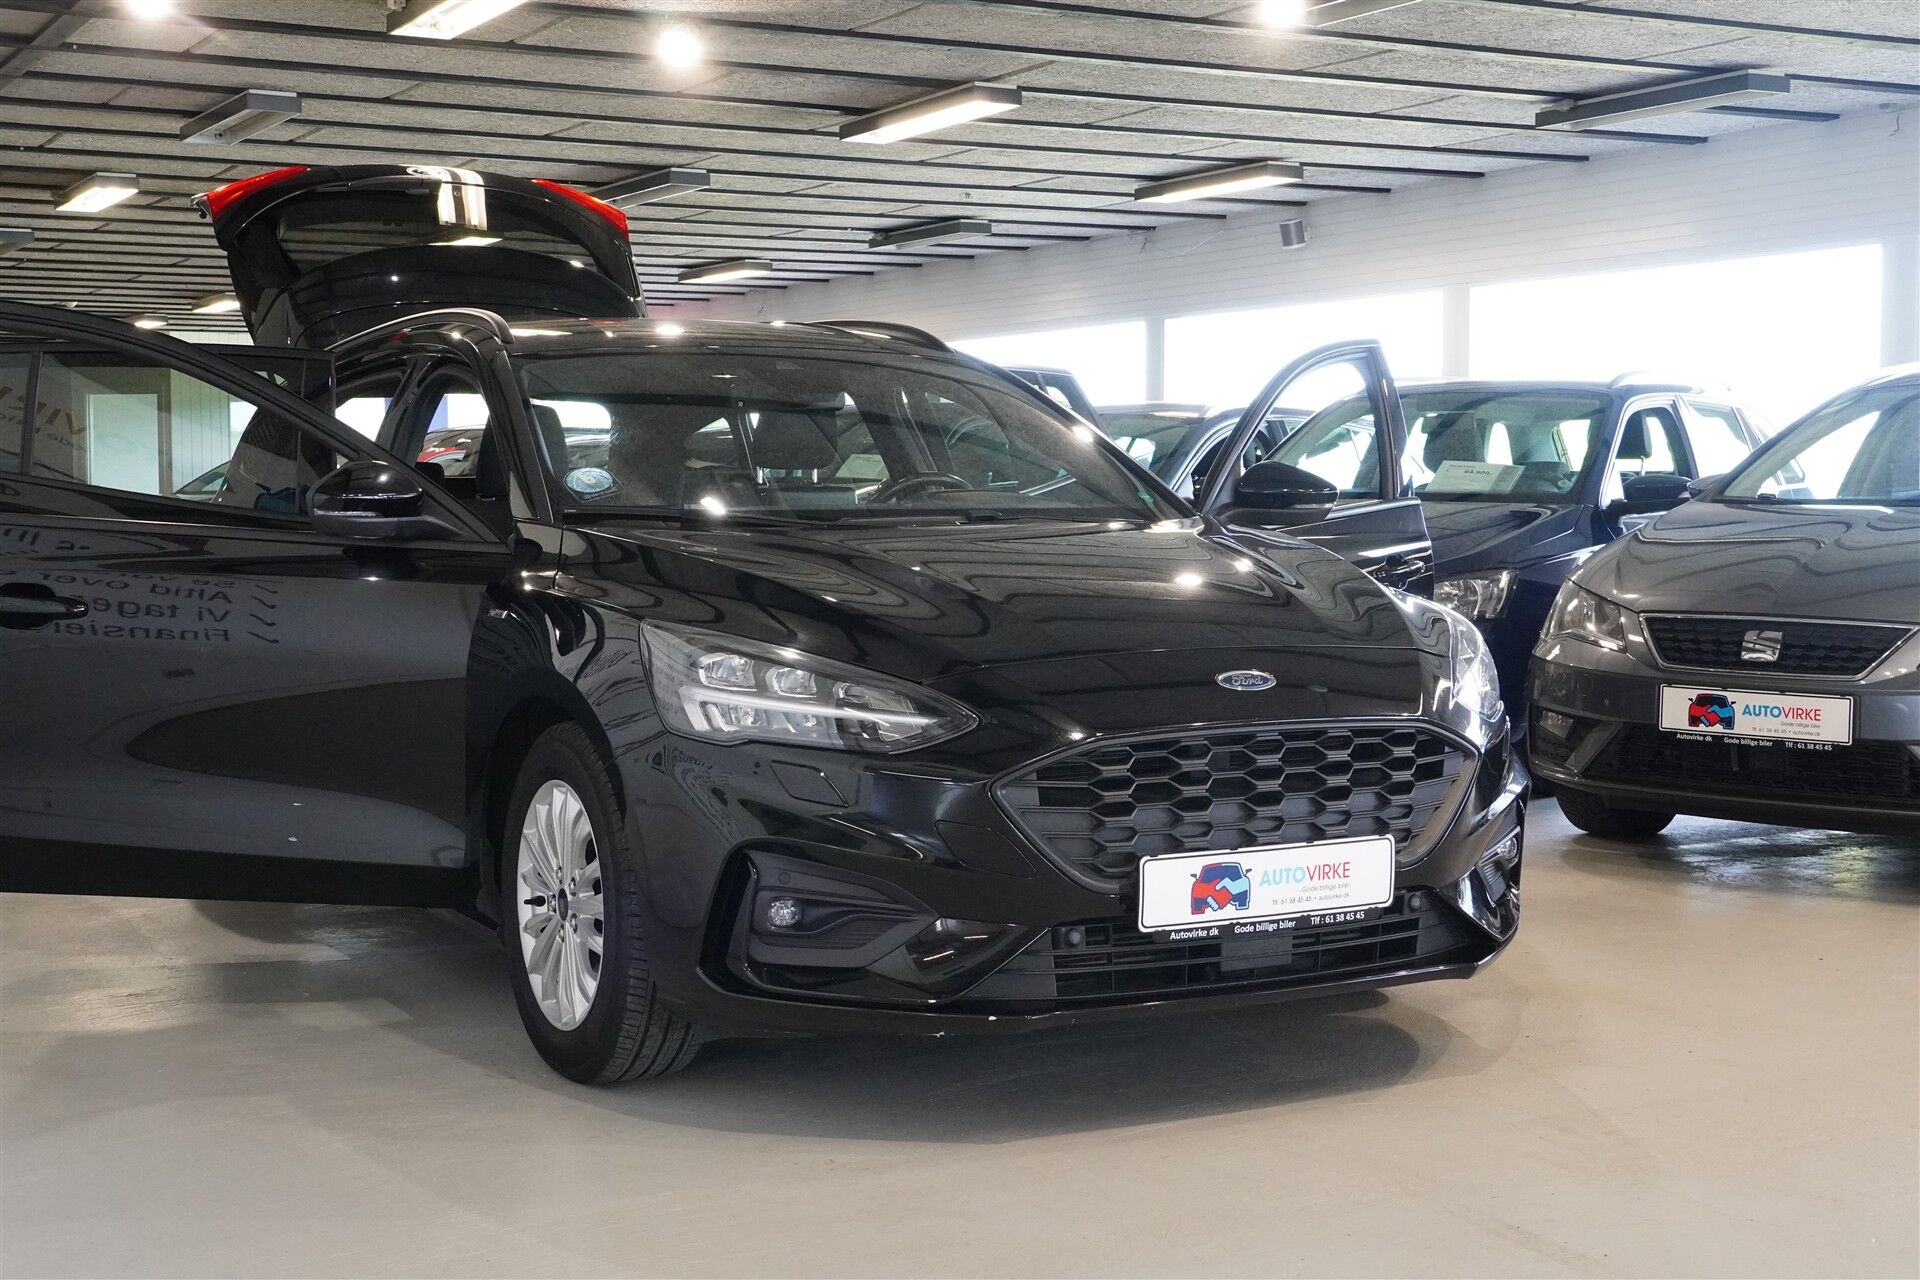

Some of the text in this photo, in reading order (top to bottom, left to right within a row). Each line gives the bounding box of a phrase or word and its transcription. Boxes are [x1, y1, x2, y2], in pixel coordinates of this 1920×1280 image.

[1742, 704, 1822, 722] AUTOVIRKE
[1676, 733, 1704, 741] Autovirke
[1740, 738, 1758, 747] billige
[1759, 739, 1773, 747] biler
[1259, 861, 1351, 887] AUTOVIRKE
[1170, 929, 1207, 940] Autovirke
[1209, 927, 1219, 937] dk
[1234, 925, 1254, 934] Gode
[1256, 922, 1278, 932] billige
[1279, 920, 1296, 929] biler
[1311, 915, 1321, 925] Tlf
[1325, 914, 1334, 924] 61
[1335, 913, 1345, 922] 38
[1345, 912, 1355, 921] 45
[1356, 911, 1365, 920] 45
